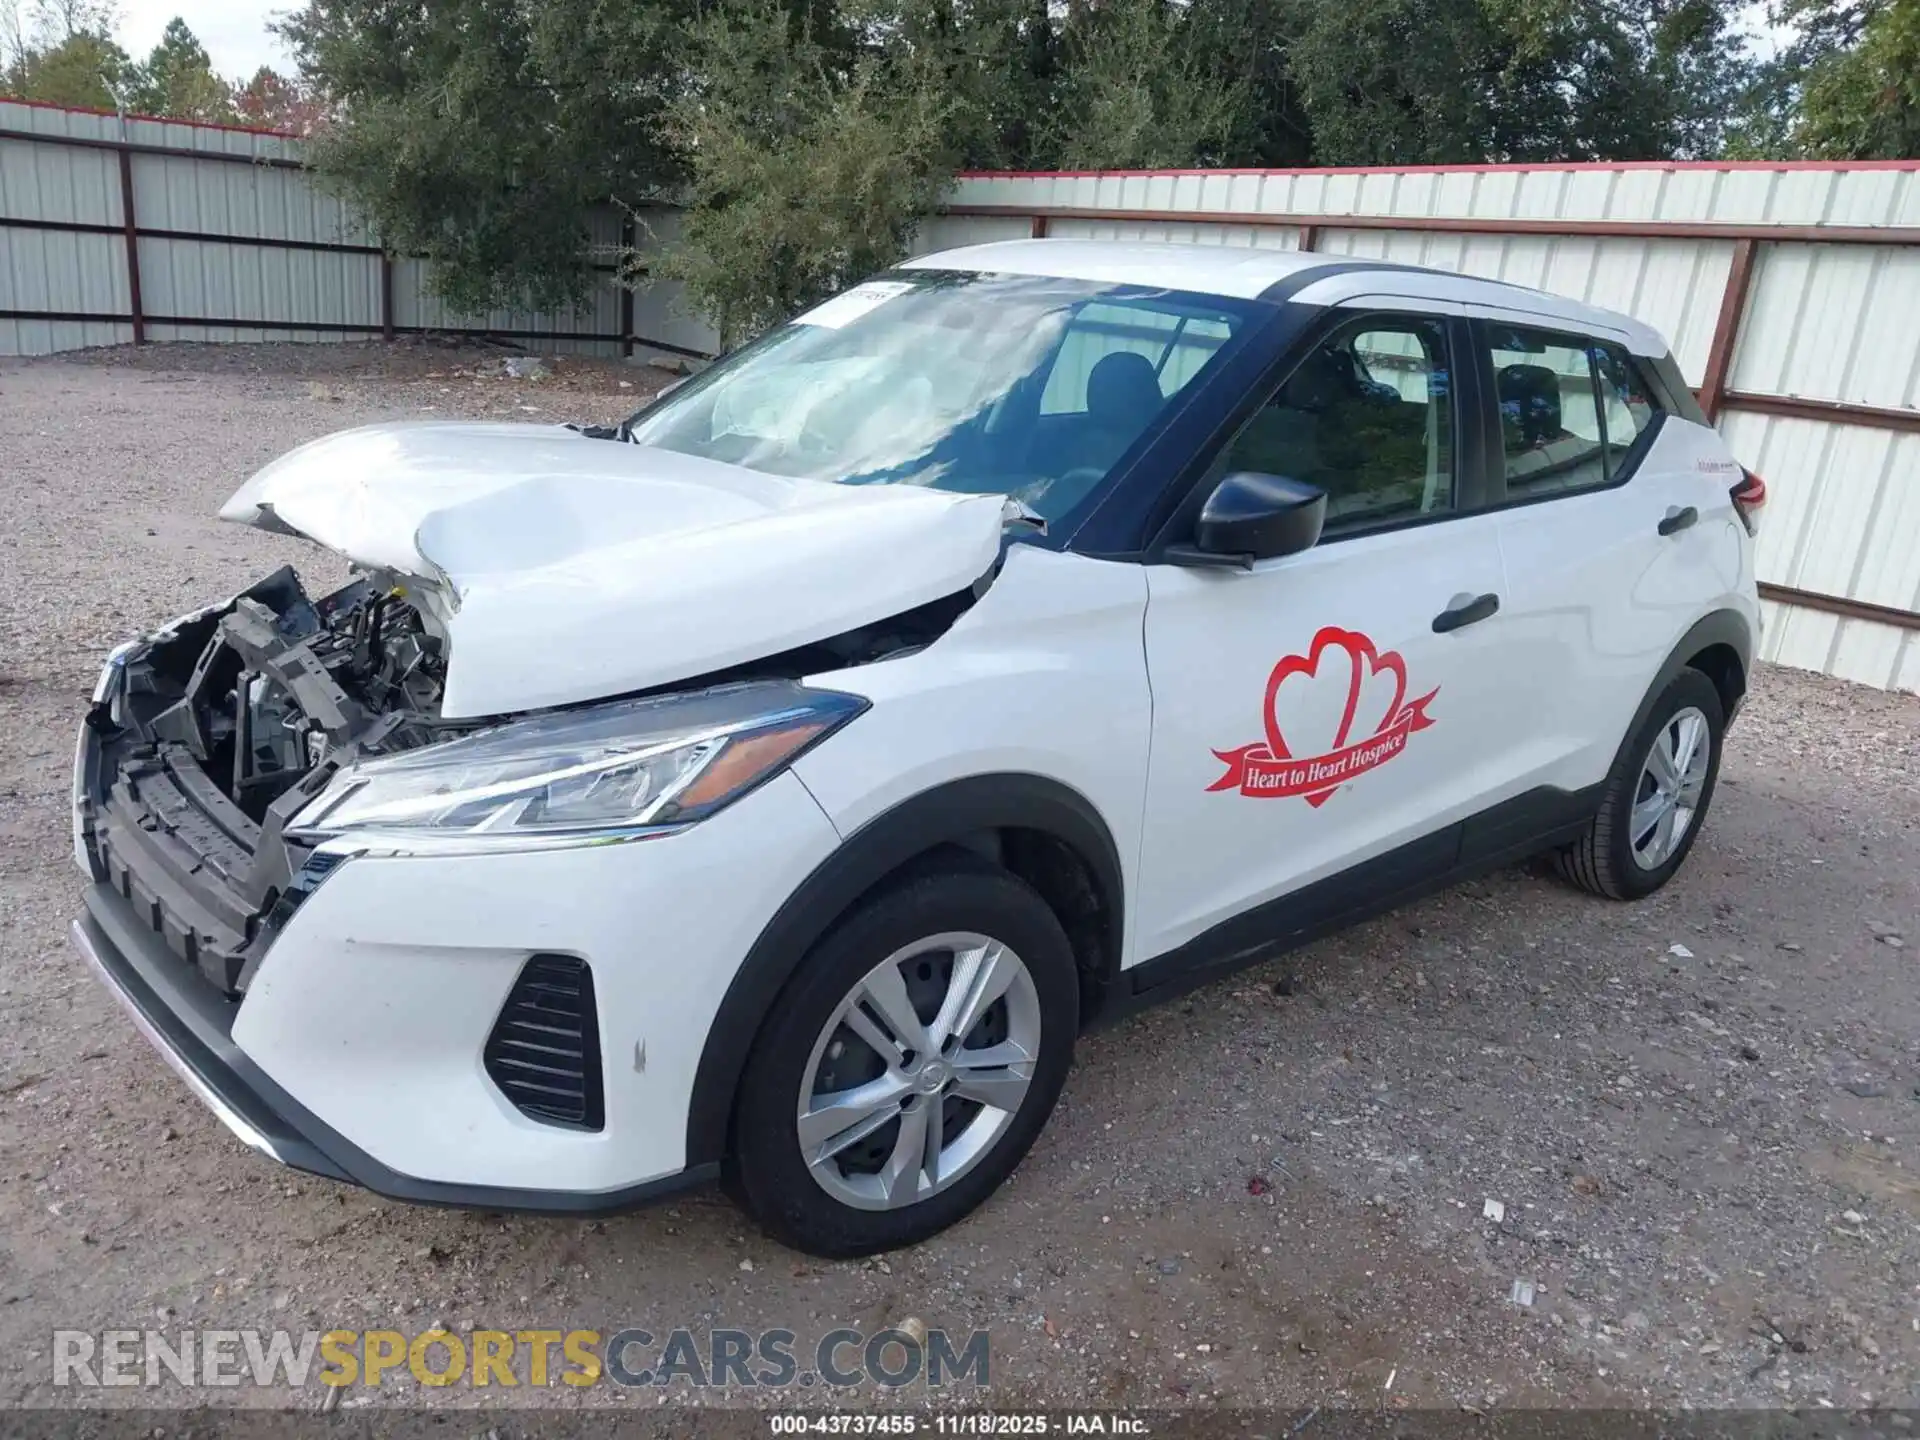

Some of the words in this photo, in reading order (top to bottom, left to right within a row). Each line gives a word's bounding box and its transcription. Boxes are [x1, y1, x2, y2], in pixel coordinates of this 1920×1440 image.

[1246, 767, 1287, 788] Heart
[1290, 768, 1305, 785] to
[1307, 757, 1347, 783] Heart
[1349, 732, 1405, 769] Hospice
